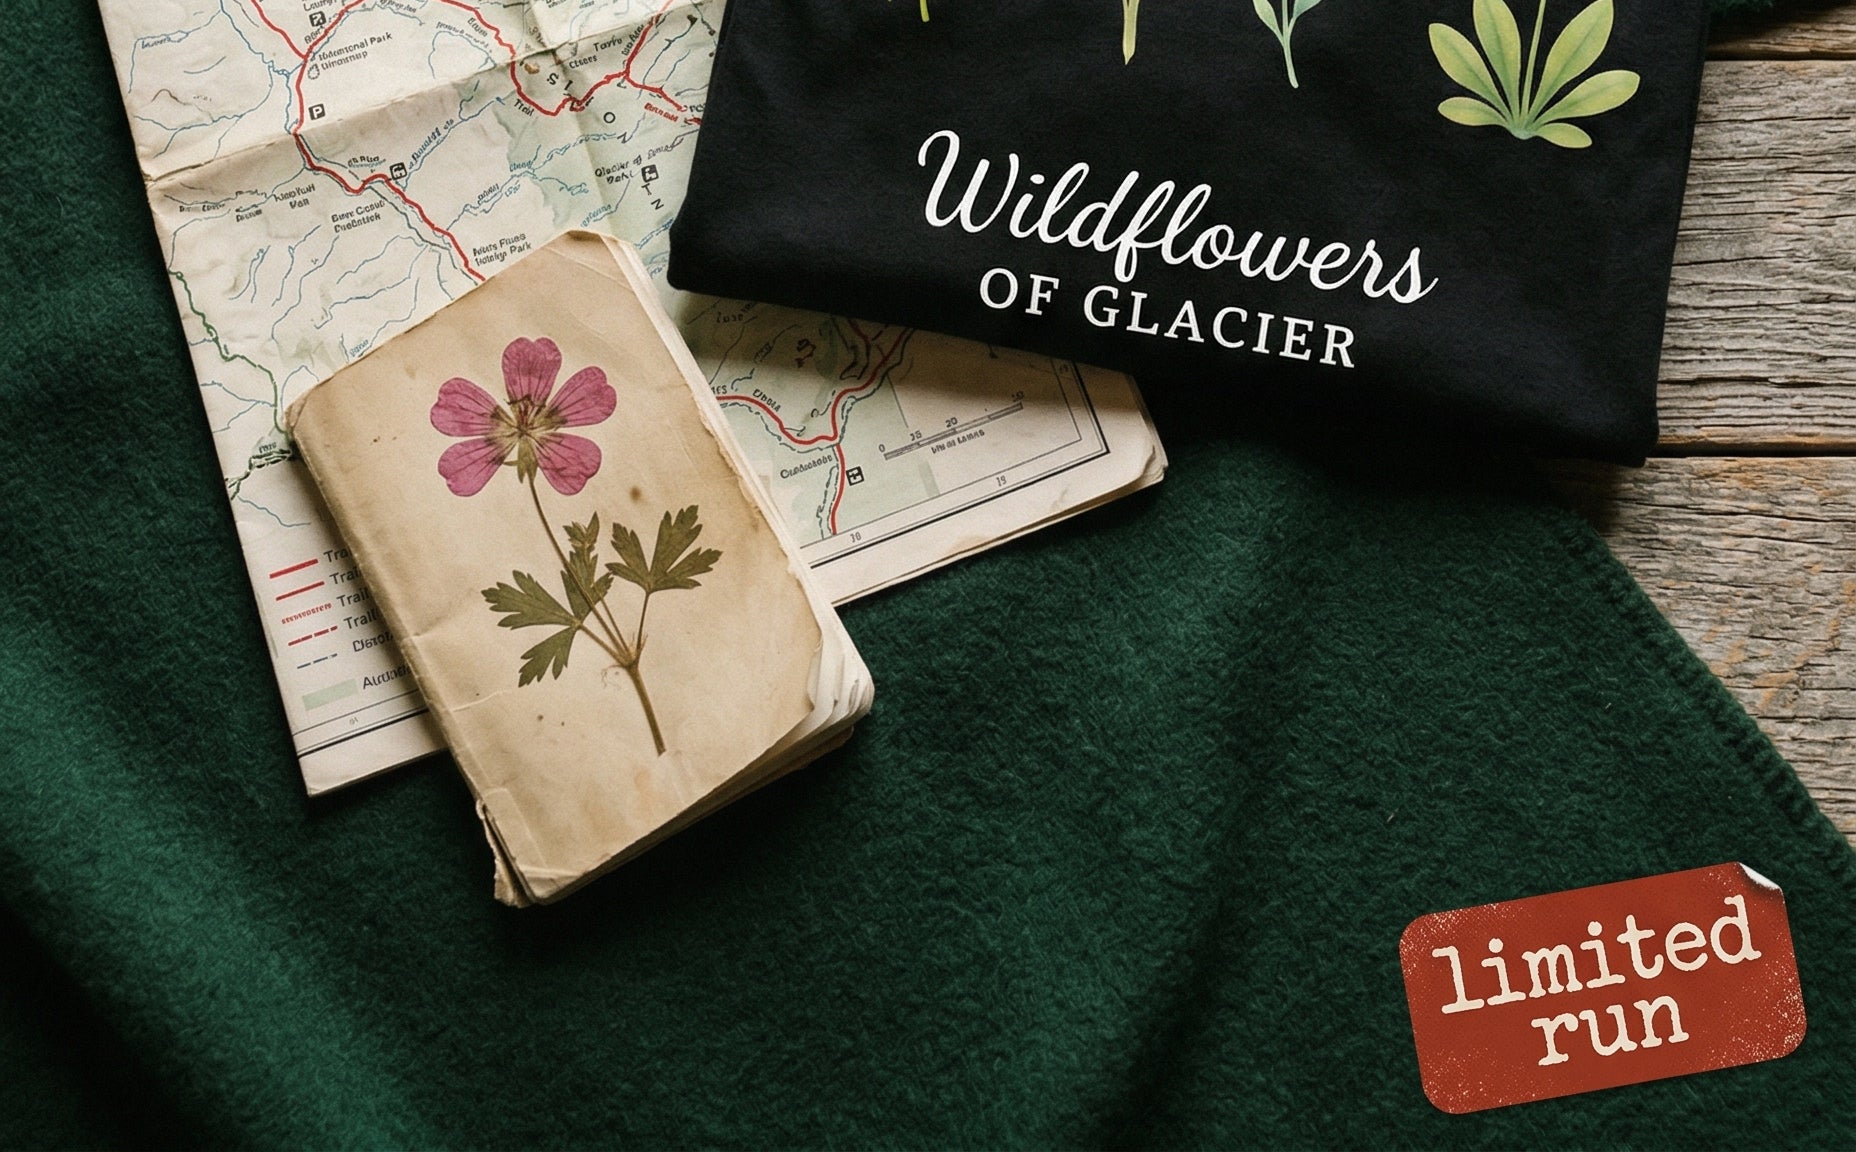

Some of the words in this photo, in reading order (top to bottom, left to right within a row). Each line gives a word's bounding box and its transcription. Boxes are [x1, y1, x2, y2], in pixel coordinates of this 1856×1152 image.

[917, 129, 1439, 304] Wildflowers
[980, 267, 1060, 316] OF
[1083, 285, 1356, 369] GLACIER
